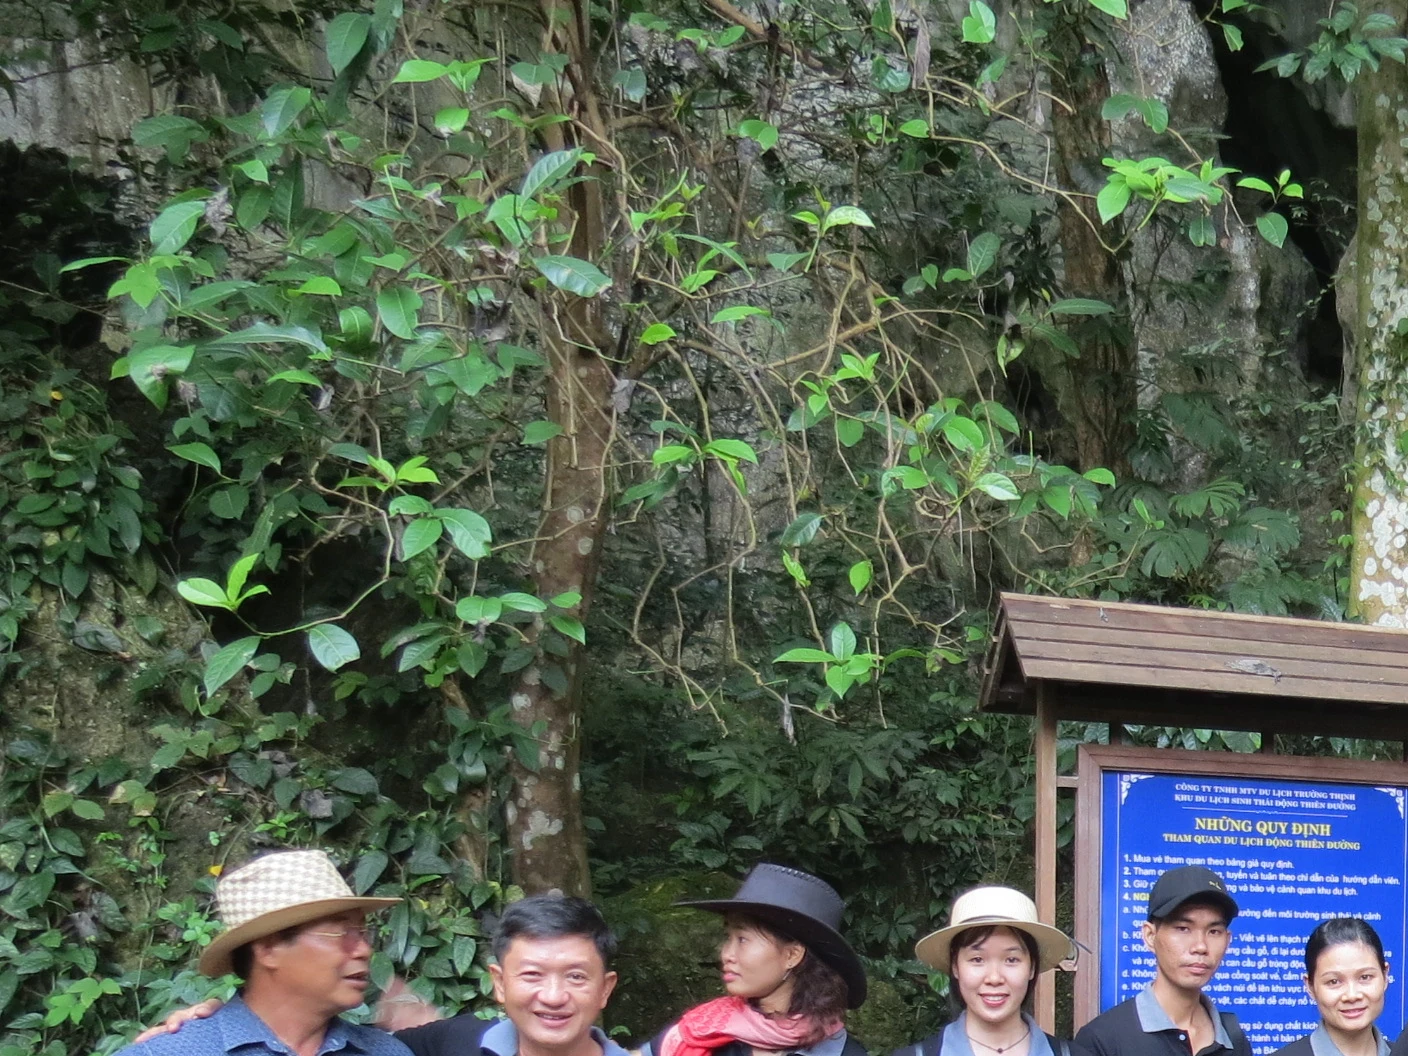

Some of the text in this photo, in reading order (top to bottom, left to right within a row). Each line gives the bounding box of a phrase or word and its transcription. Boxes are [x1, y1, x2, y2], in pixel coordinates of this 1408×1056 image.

[1175, 782, 1200, 792] CÔNG
[1201, 785, 1212, 793] TY
[1214, 786, 1237, 794] TNHH
[1239, 787, 1258, 796] MTV
[1259, 788, 1273, 796] DU
[1274, 788, 1292, 798] LỊCH
[1329, 792, 1356, 802] THỊNH
[1174, 793, 1194, 802] KHU
[1195, 795, 1208, 803] DU
[1209, 796, 1230, 805] LỊCH
[1231, 797, 1252, 805] SINH
[1275, 799, 1299, 809] ĐỘNG
[1300, 799, 1325, 809] THIÊN
[1194, 816, 1332, 838] NHỮNG QUY ĐỊNH
[1163, 833, 1361, 851] THAM QUAN DU LỊCH ĐỘNG THIÊN ĐƯỜNG
[1124, 854, 1132, 863] 1.
[1133, 855, 1151, 863] Mua
[1164, 856, 1184, 865] tham
[1186, 858, 1206, 866] quan
[1207, 857, 1225, 866] theo
[1261, 860, 1275, 870] quy
[1123, 867, 1131, 875] 2.
[1133, 867, 1156, 876] Tham
[1249, 871, 1259, 880] và
[1279, 873, 1296, 882] theo
[1238, 884, 1248, 892] và
[1297, 887, 1316, 896] quan
[1317, 886, 1331, 895] khu
[1333, 887, 1342, 895] du
[1344, 887, 1358, 897] lịch.
[1123, 893, 1131, 901] 4.
[1321, 911, 1336, 919] sinh
[1122, 931, 1131, 939] b.
[1271, 947, 1279, 955] đi
[1132, 957, 1142, 965] và
[1122, 969, 1130, 977] d.
[1215, 972, 1230, 980] qua
[1271, 984, 1286, 993] khu
